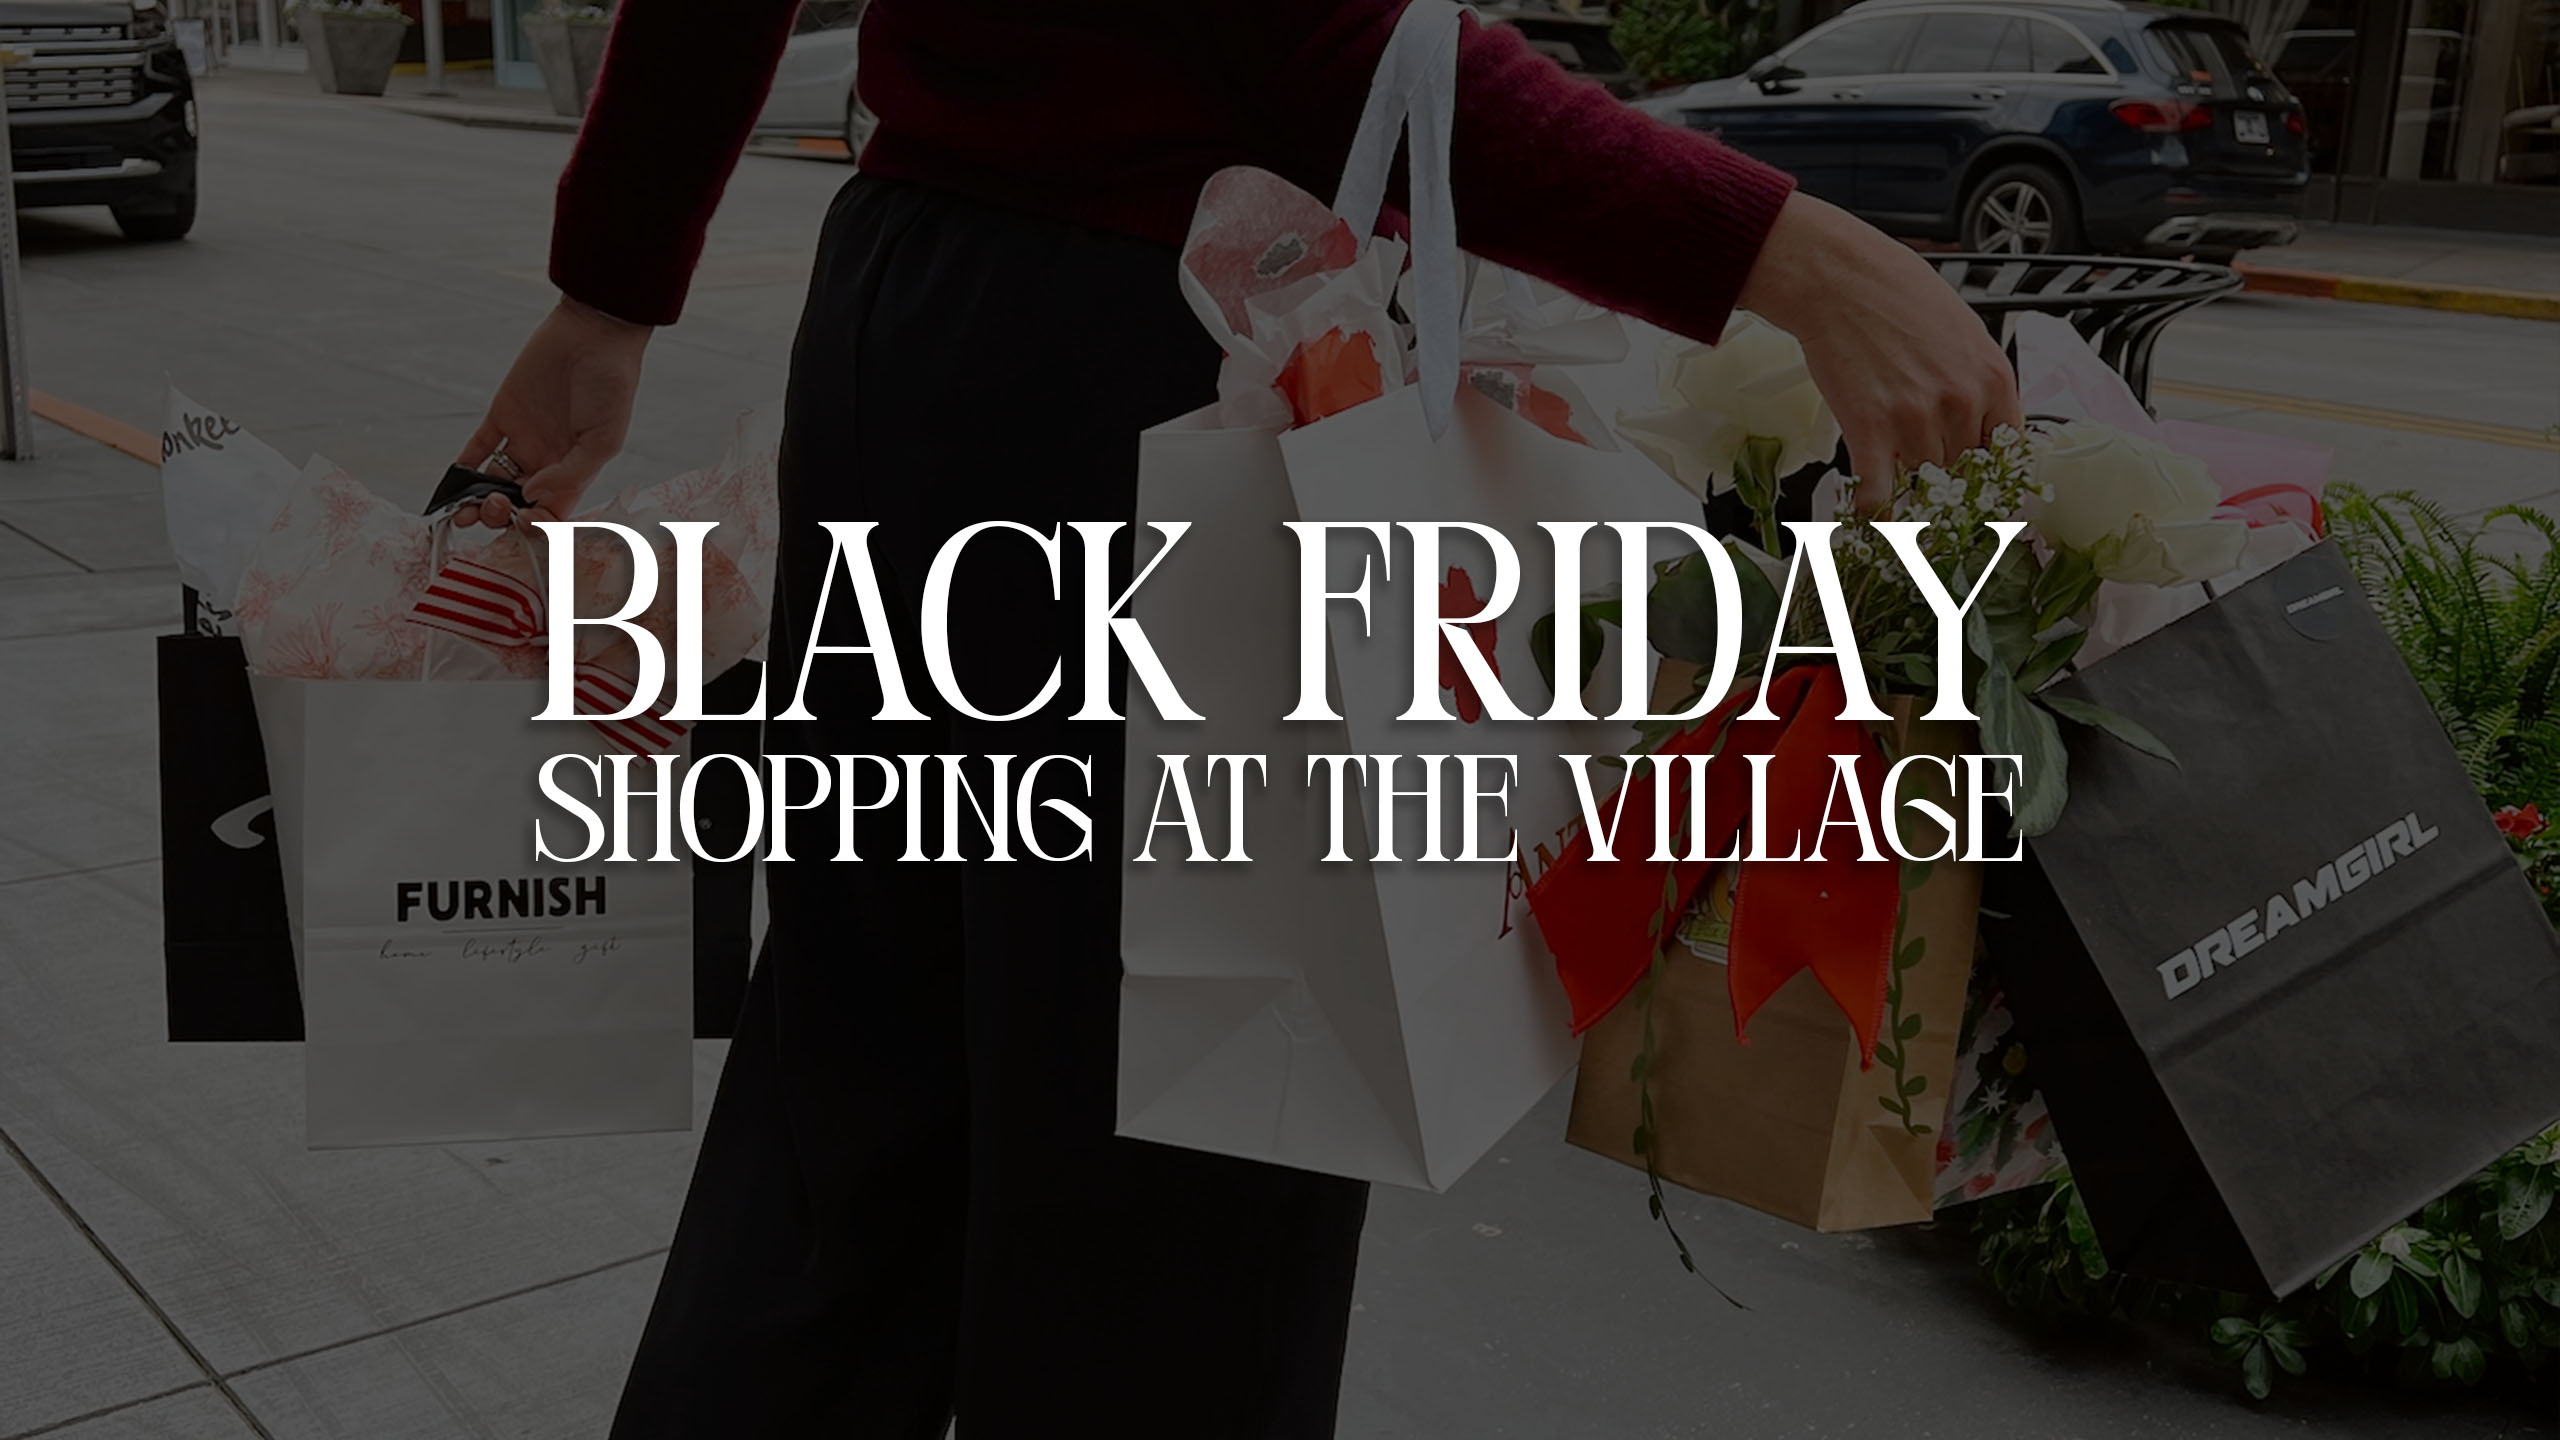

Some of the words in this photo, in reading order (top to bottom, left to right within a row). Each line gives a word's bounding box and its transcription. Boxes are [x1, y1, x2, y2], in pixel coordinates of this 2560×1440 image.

[397, 876, 606, 923] FURNISH
[2155, 810, 2440, 1000] DREAMGIRL
[379, 939, 432, 961] home
